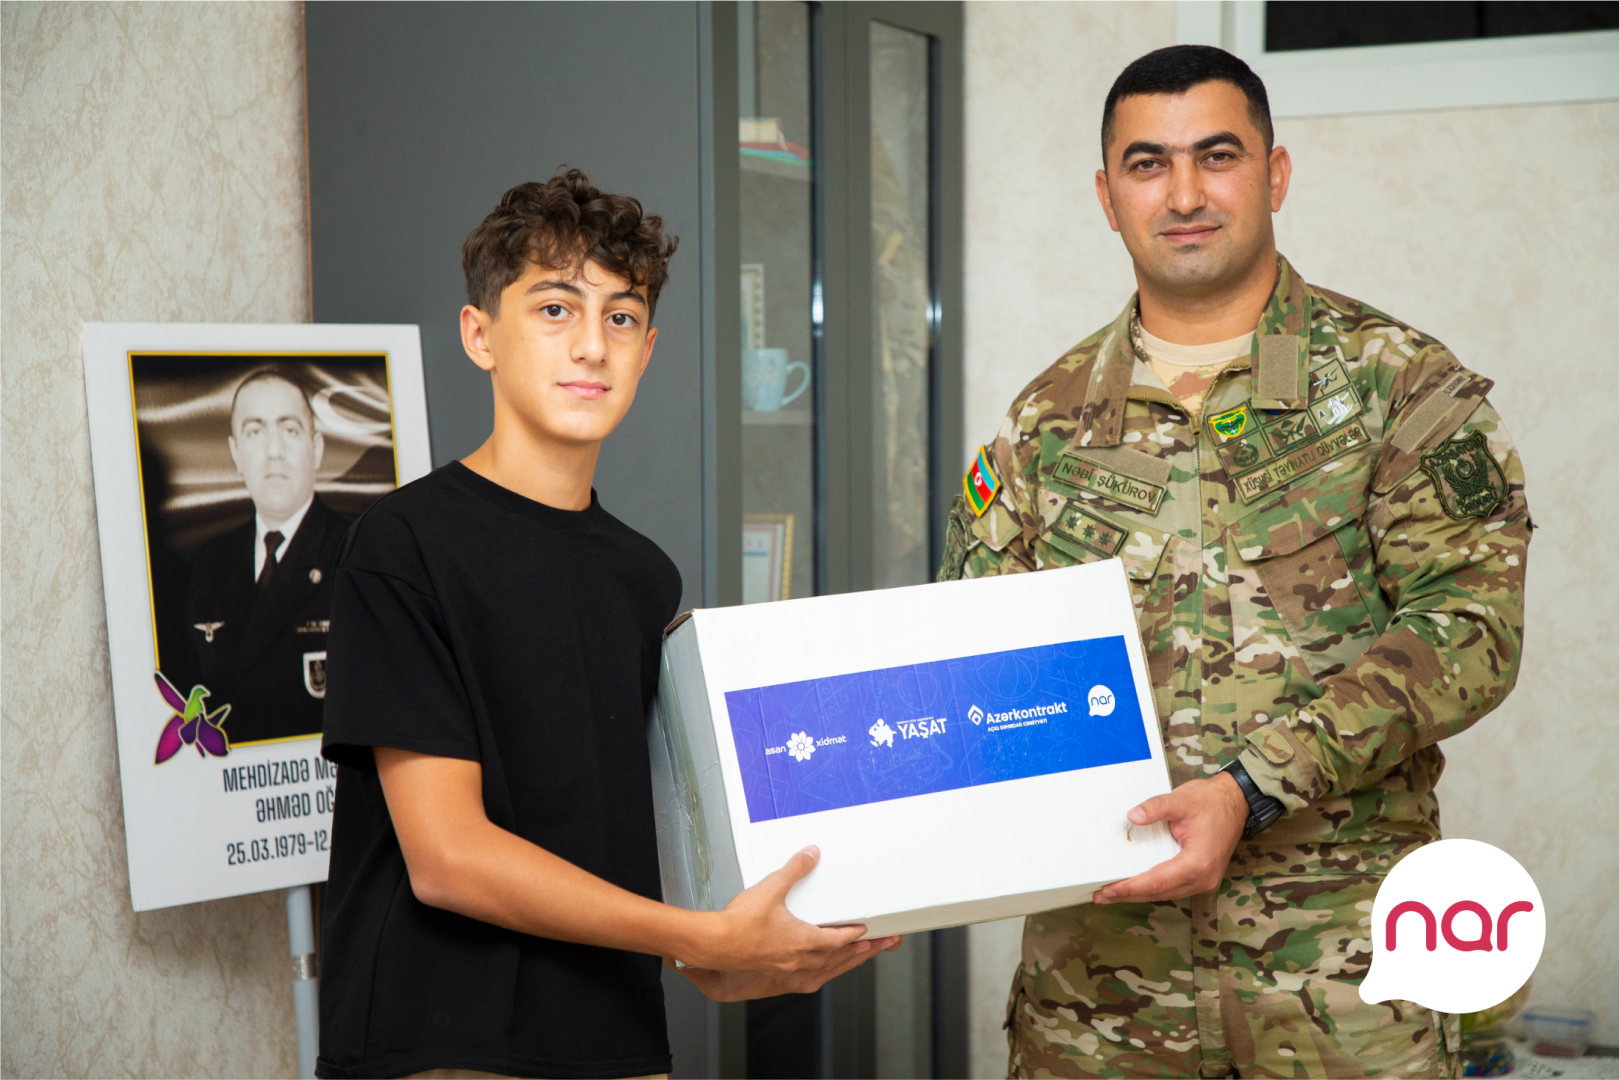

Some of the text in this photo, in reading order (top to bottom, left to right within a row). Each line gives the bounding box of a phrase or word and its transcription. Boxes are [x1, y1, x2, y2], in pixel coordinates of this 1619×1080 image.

[1243, 426, 1363, 493] XÜSUSİ TƏYİNATLI QÜVVƏLƏR
[1061, 462, 1157, 503] NƏBİ ŞÜKÜROV
[986, 701, 1068, 724] Azərkontrakt
[1090, 694, 1112, 707] nar
[897, 717, 947, 740] YAŞAT
[765, 735, 847, 755] asan xidmat
[223, 758, 310, 793] MEHDİZADƏ
[255, 792, 311, 823] ƏHMƏD
